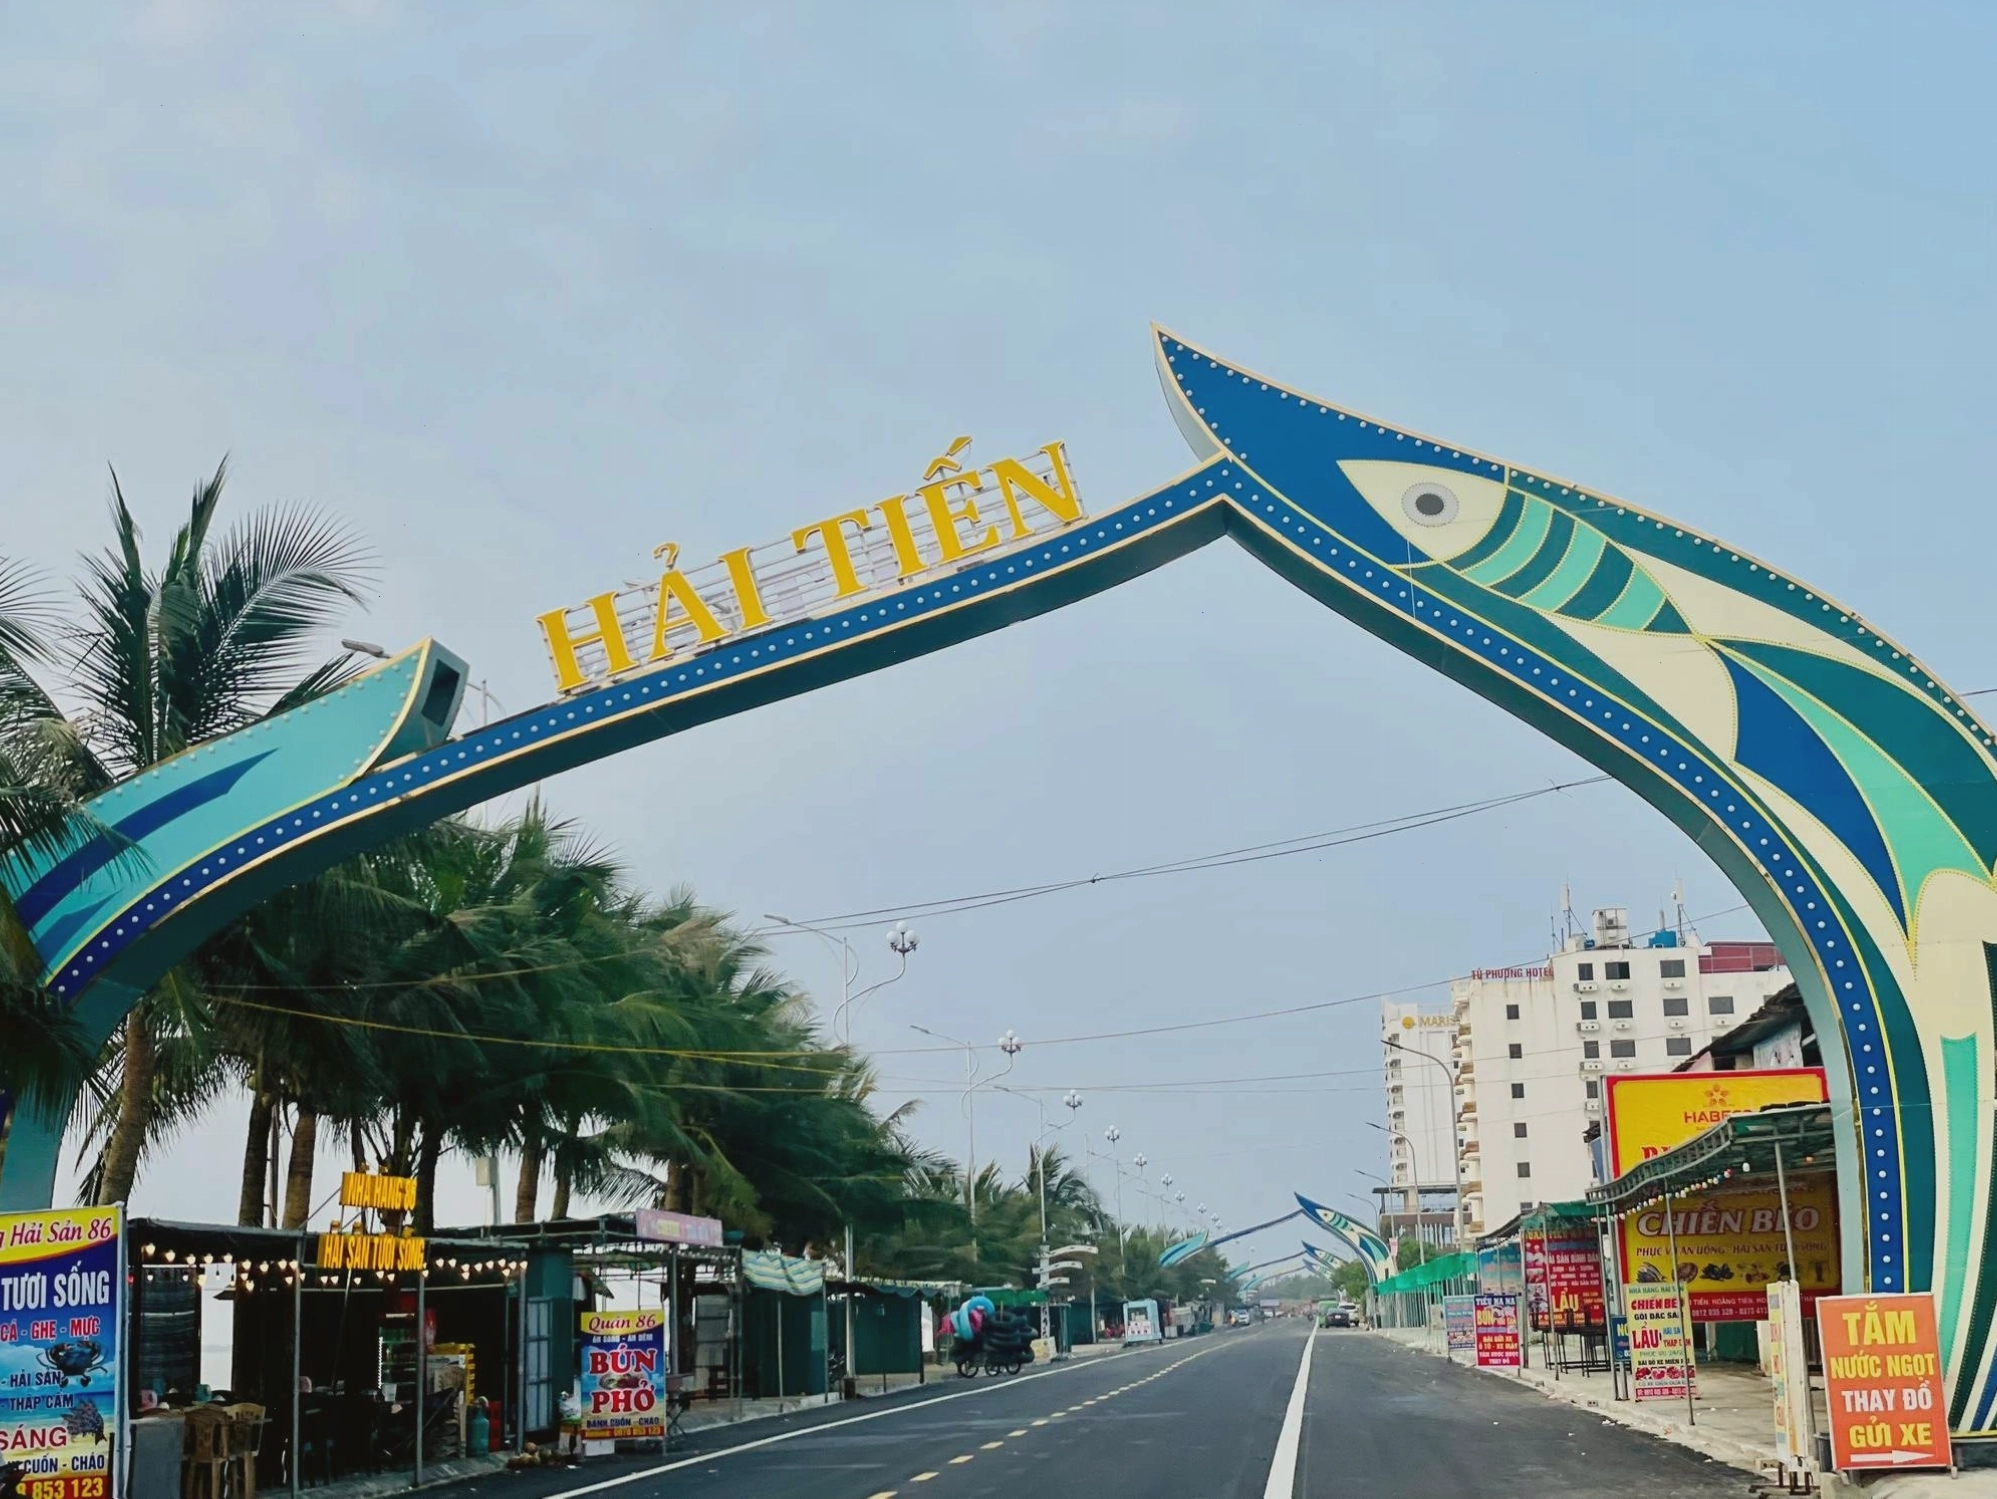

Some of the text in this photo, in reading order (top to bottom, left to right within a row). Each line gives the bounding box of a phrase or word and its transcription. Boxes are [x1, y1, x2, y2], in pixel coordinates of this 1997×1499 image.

[536, 435, 1084, 694] HẢI TIẾN
[1526, 967, 1554, 978] HOTEL
[10, 1222, 42, 1247] Hải
[87, 1218, 112, 1240] 86
[1, 1260, 110, 1311] TƯƠI SỐNG
[1552, 1287, 1579, 1312] LẨU
[31, 1320, 57, 1343] GHẸ
[70, 1315, 101, 1341] MỰC
[589, 1314, 656, 1332] Quán 86
[1632, 1321, 1659, 1348] LẨU
[1842, 1301, 1917, 1346] TẮM
[589, 1344, 656, 1375] BÚN
[1830, 1350, 1935, 1381] NƯỚC NGỌT
[10, 1369, 31, 1388] HẢI
[35, 1366, 61, 1387] SẢN
[591, 1380, 655, 1414] PHỞ
[1841, 1380, 1933, 1412] THAY ĐỒ
[0, 1424, 67, 1451] SÁNG
[1850, 1415, 1933, 1448] GỬI XE
[23, 1453, 58, 1474] CUỐN
[71, 1452, 104, 1471] CHÁO
[71, 1477, 104, 1497] 123
